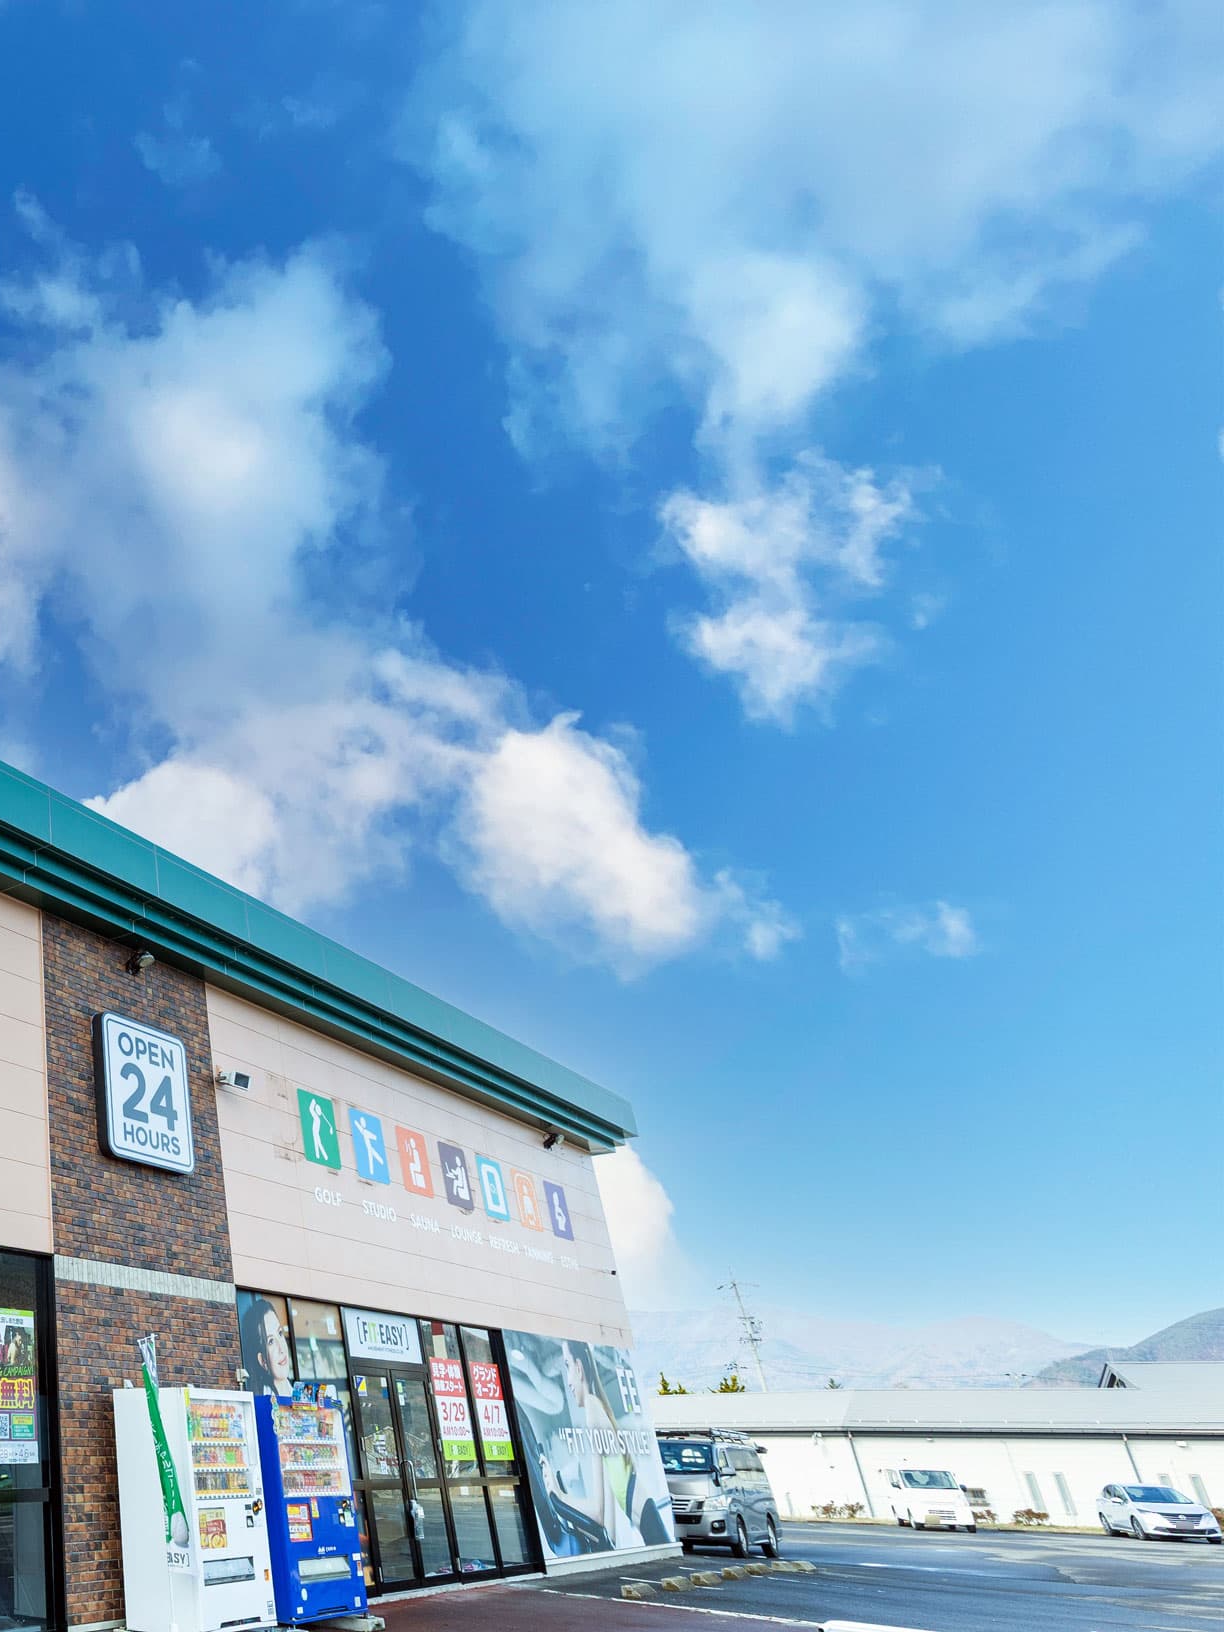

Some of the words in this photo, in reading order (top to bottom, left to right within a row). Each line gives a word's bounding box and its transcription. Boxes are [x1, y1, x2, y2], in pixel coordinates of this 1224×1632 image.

[118, 1031, 175, 1073] OPEN
[120, 1063, 178, 1132] 24
[122, 1121, 182, 1157] HOURS
[314, 1186, 343, 1207] GOLF
[362, 1200, 397, 1223] STUDIO
[409, 1213, 440, 1233] SAUNA
[451, 1224, 484, 1245] LOUNGE
[473, 1365, 497, 1383] グランド
[0, 1378, 34, 1408] 無料
[475, 1381, 499, 1397] オープン
[441, 1401, 466, 1422] 3/29
[484, 1405, 500, 1423] 4/7
[586, 1428, 617, 1454] YOUR
